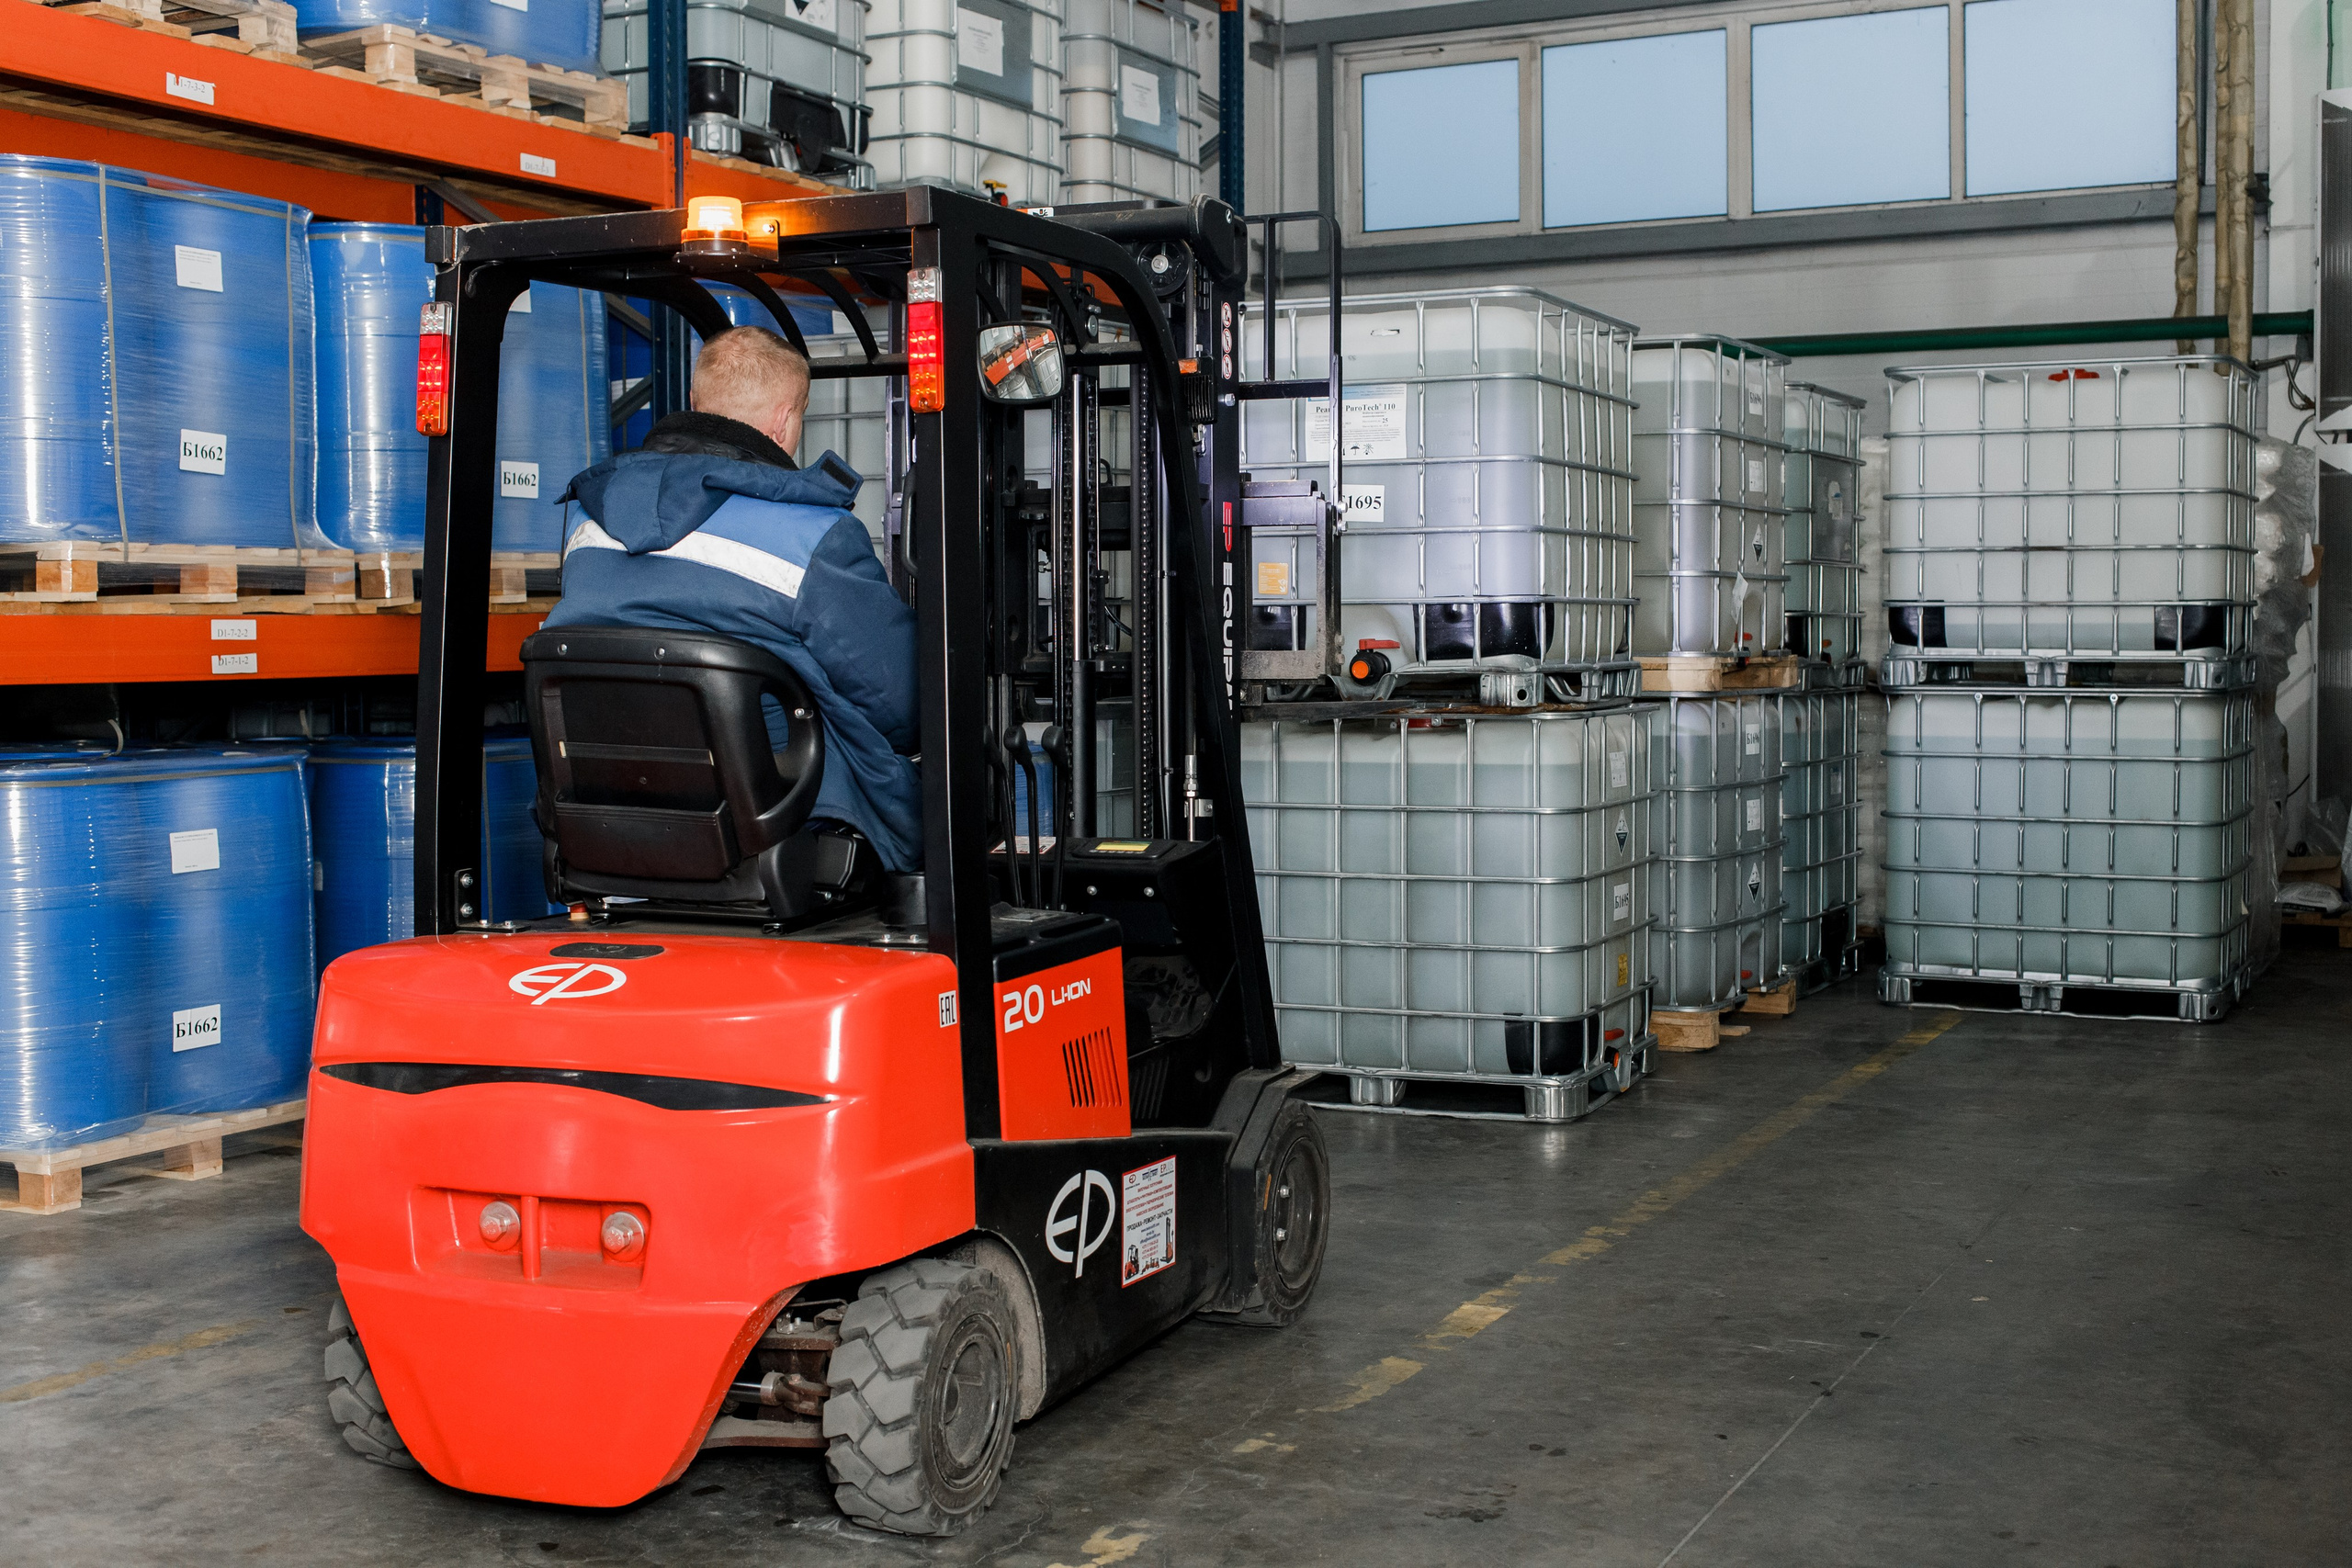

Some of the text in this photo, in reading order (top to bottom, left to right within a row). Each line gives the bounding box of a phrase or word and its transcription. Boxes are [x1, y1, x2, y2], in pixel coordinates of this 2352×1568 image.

[183, 442, 223, 461] Б1662
[503, 471, 537, 487] Б1662
[1342, 495, 1382, 510] 1695
[217, 628, 248, 637] D1-7-2-2
[218, 656, 249, 666] D1-7-1-2
[1002, 984, 1045, 1033] 20
[175, 1016, 218, 1038] Б1662
